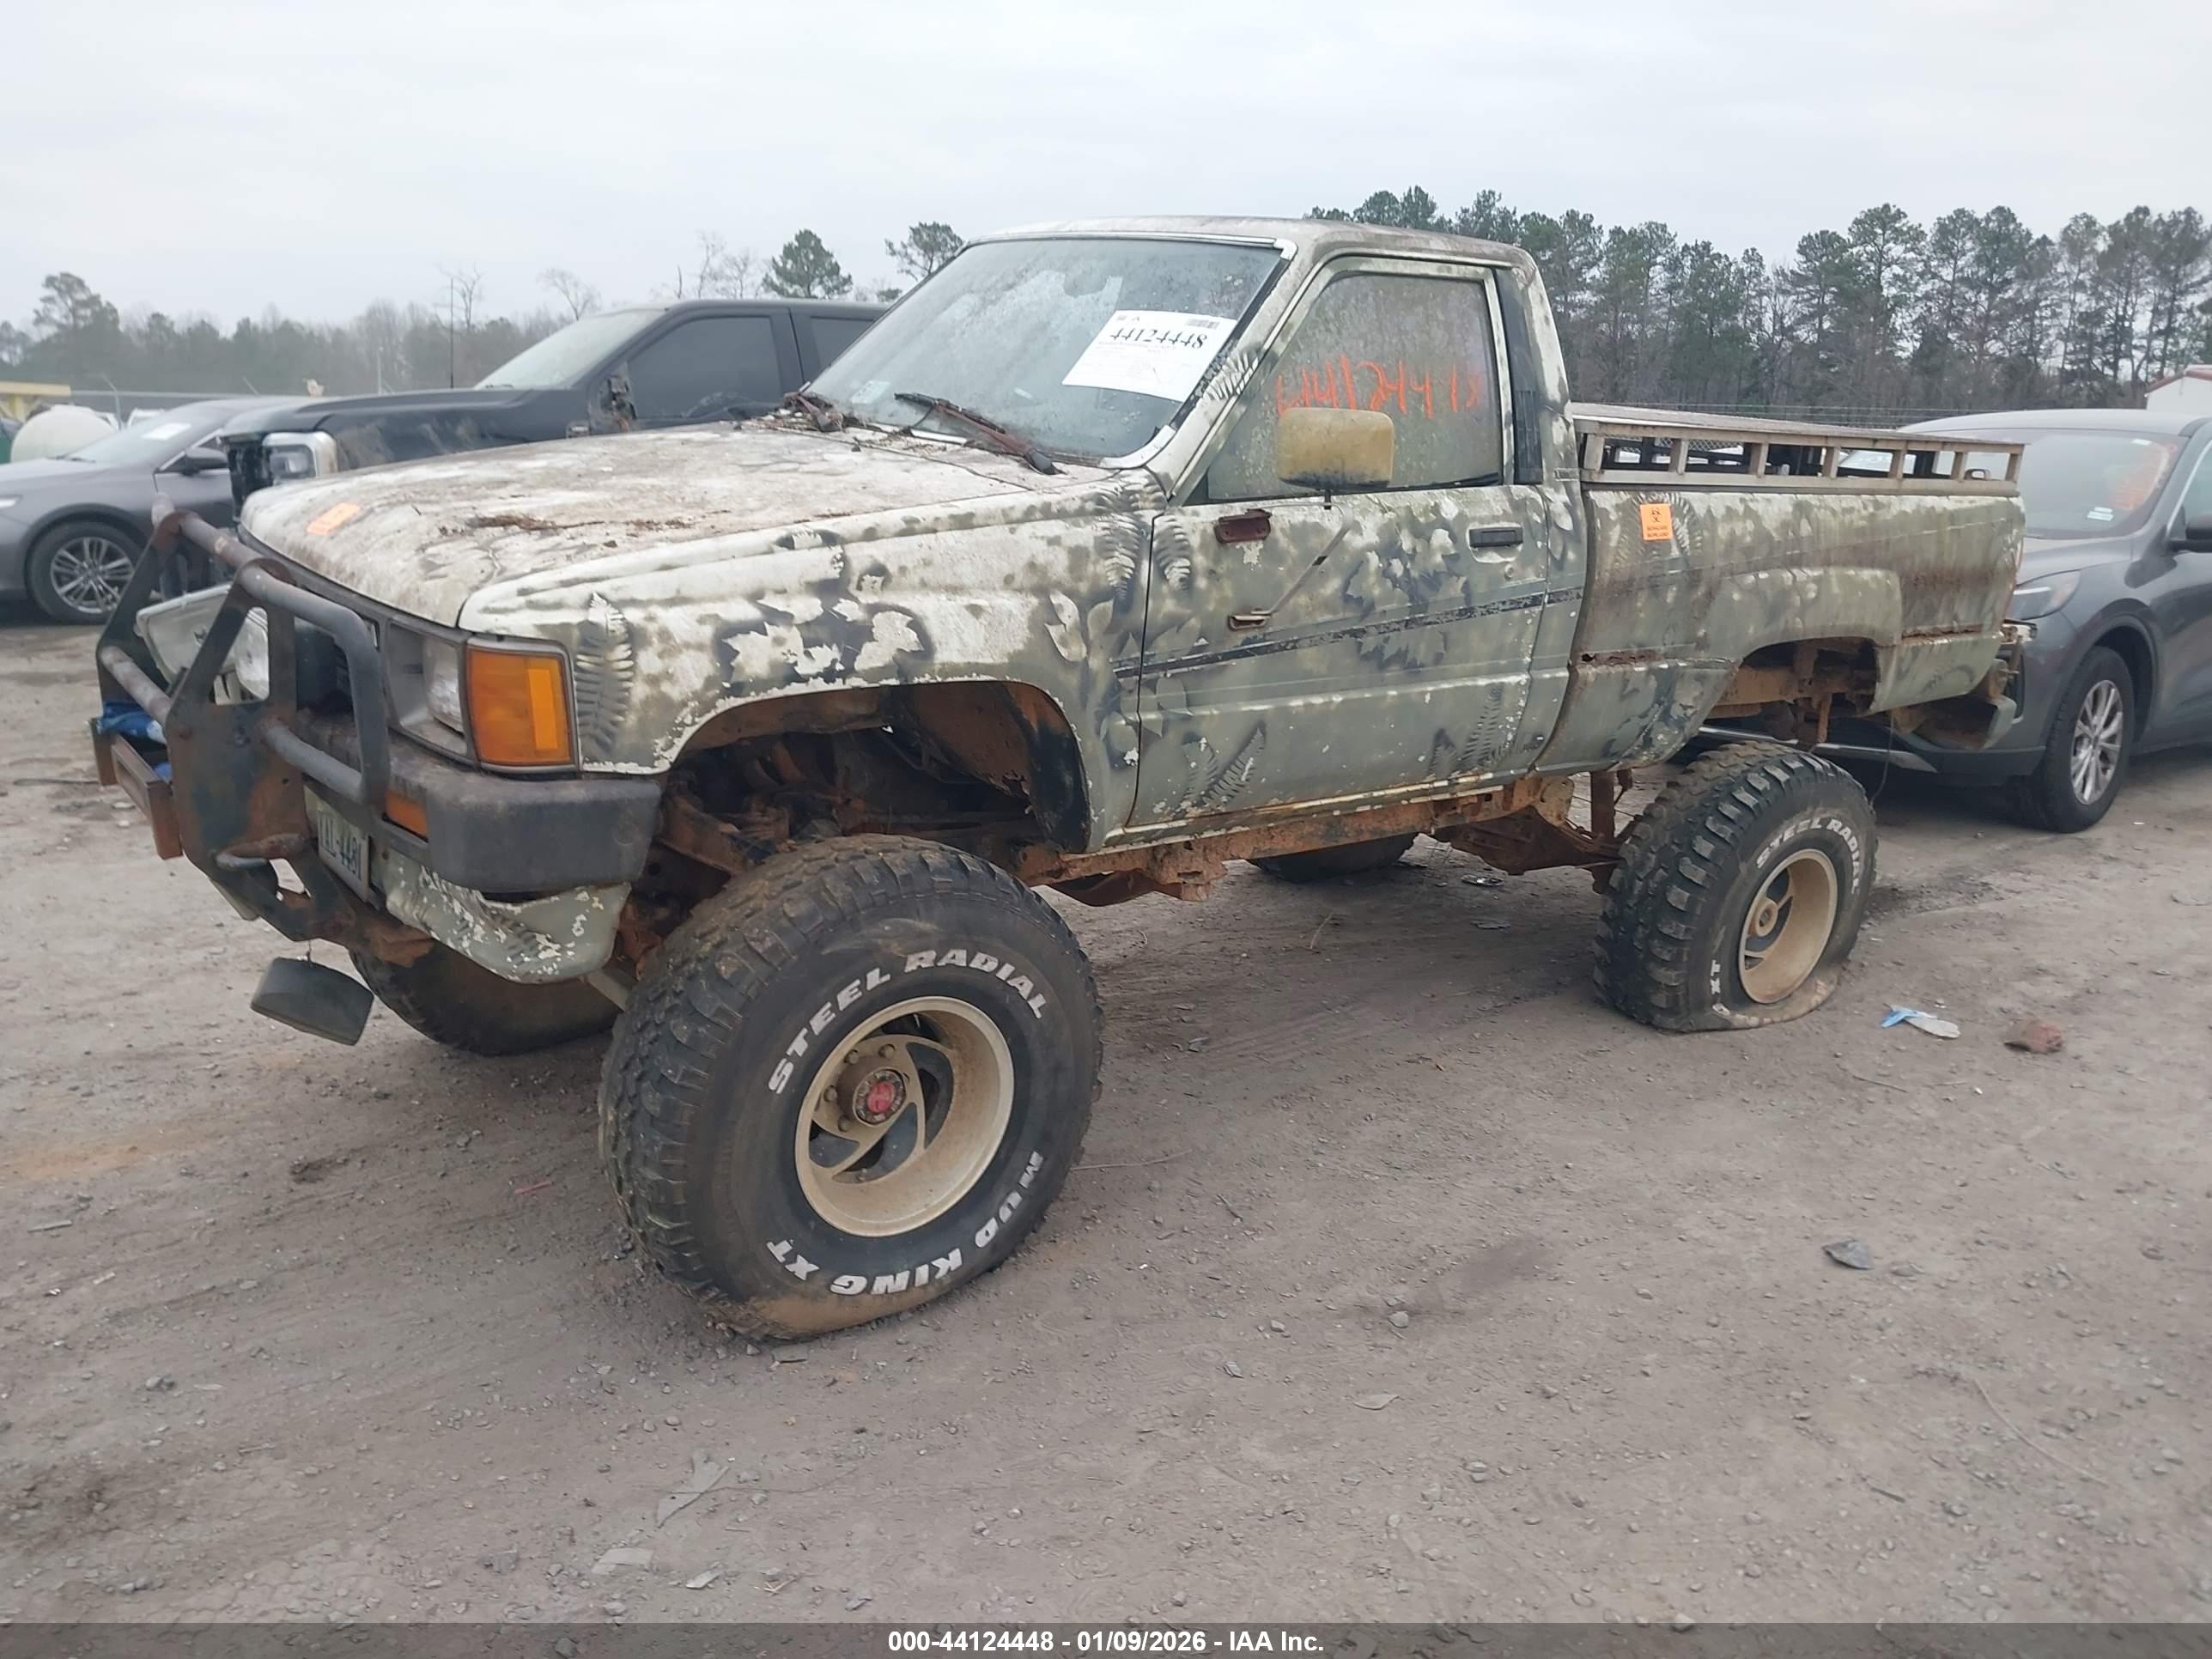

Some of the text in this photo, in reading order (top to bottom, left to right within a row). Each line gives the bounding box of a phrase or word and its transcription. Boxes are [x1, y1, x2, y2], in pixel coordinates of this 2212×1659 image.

[1110, 326, 1207, 349] 44124448
[1756, 817, 1863, 895] STEEL RADIAL
[768, 949, 1048, 1095] STEEL RADIAL
[765, 1150, 1045, 1296] MUD KING XT
